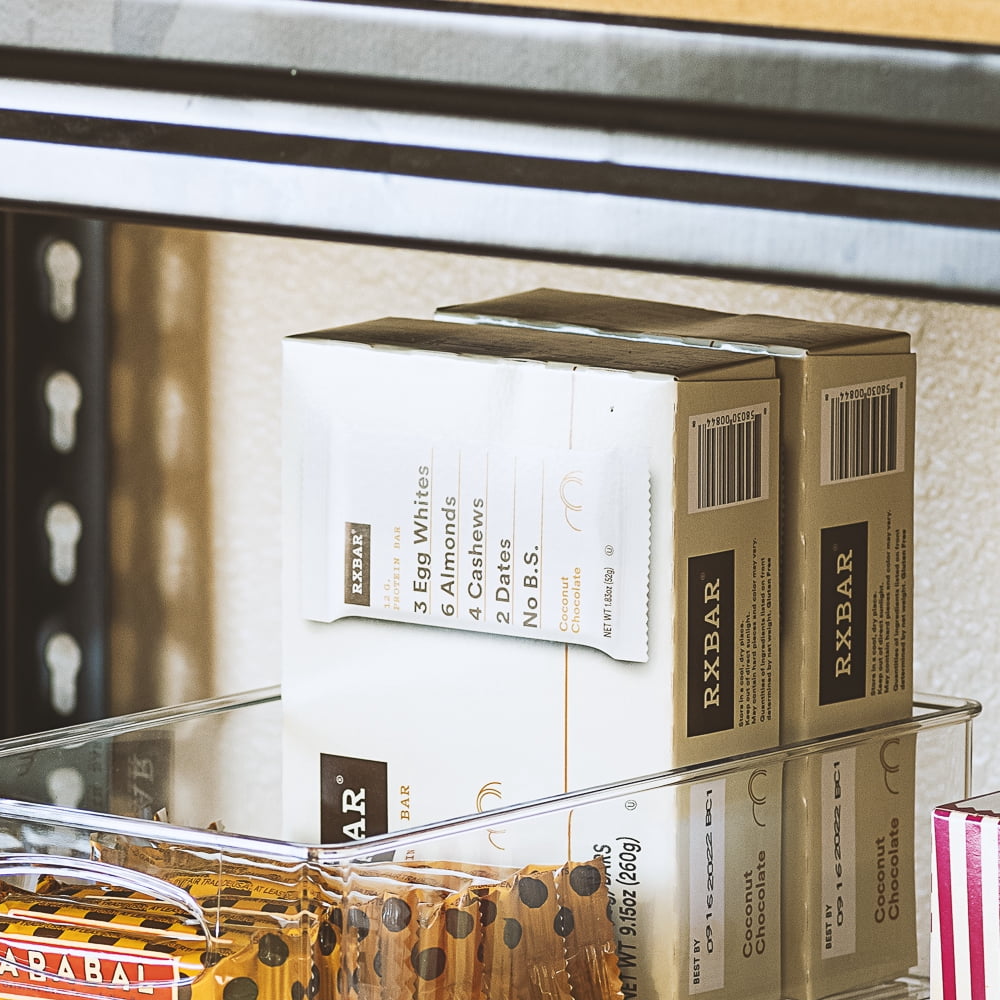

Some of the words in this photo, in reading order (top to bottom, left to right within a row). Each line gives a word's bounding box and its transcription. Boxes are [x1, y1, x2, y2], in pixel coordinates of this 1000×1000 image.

[840, 389, 864, 401] 00844
[867, 384, 890, 398] 58030
[707, 415, 729, 427] 00844
[732, 411, 754, 422] 58030
[414, 466, 429, 544] Whites
[441, 496, 456, 596] Almonds
[468, 498, 484, 599] Cashews
[352, 534, 363, 594] RXBAR
[414, 552, 431, 593] Egg
[496, 539, 510, 602] Dates
[523, 546, 539, 588] B.S.
[604, 567, 614, 585] (52g)
[384, 594, 391, 608] 12
[414, 601, 428, 614] 3
[441, 604, 455, 616] 6
[560, 577, 569, 631] Coconut
[572, 567, 581, 633] Chocolate
[604, 587, 613, 607] 1.83oz
[468, 607, 482, 621] 4
[496, 612, 510, 624] 2
[523, 598, 538, 628] No
[604, 609, 612, 621] WT
[835, 548, 853, 677] RXBAR
[603, 623, 612, 637] NET
[704, 577, 721, 708] RXBAR
[746, 677, 750, 685] of
[739, 695, 744, 703] in
[400, 785, 410, 820] BAR
[616, 837, 641, 886] (260g)
[888, 818, 899, 920] Chocolate
[874, 837, 885, 923] Coconut
[619, 890, 638, 937] 9.15oz
[743, 870, 753, 958] Coconut
[755, 850, 766, 955] Chocolate
[825, 904, 833, 918] BY
[618, 941, 637, 969] WT
[694, 939, 701, 953] BY
